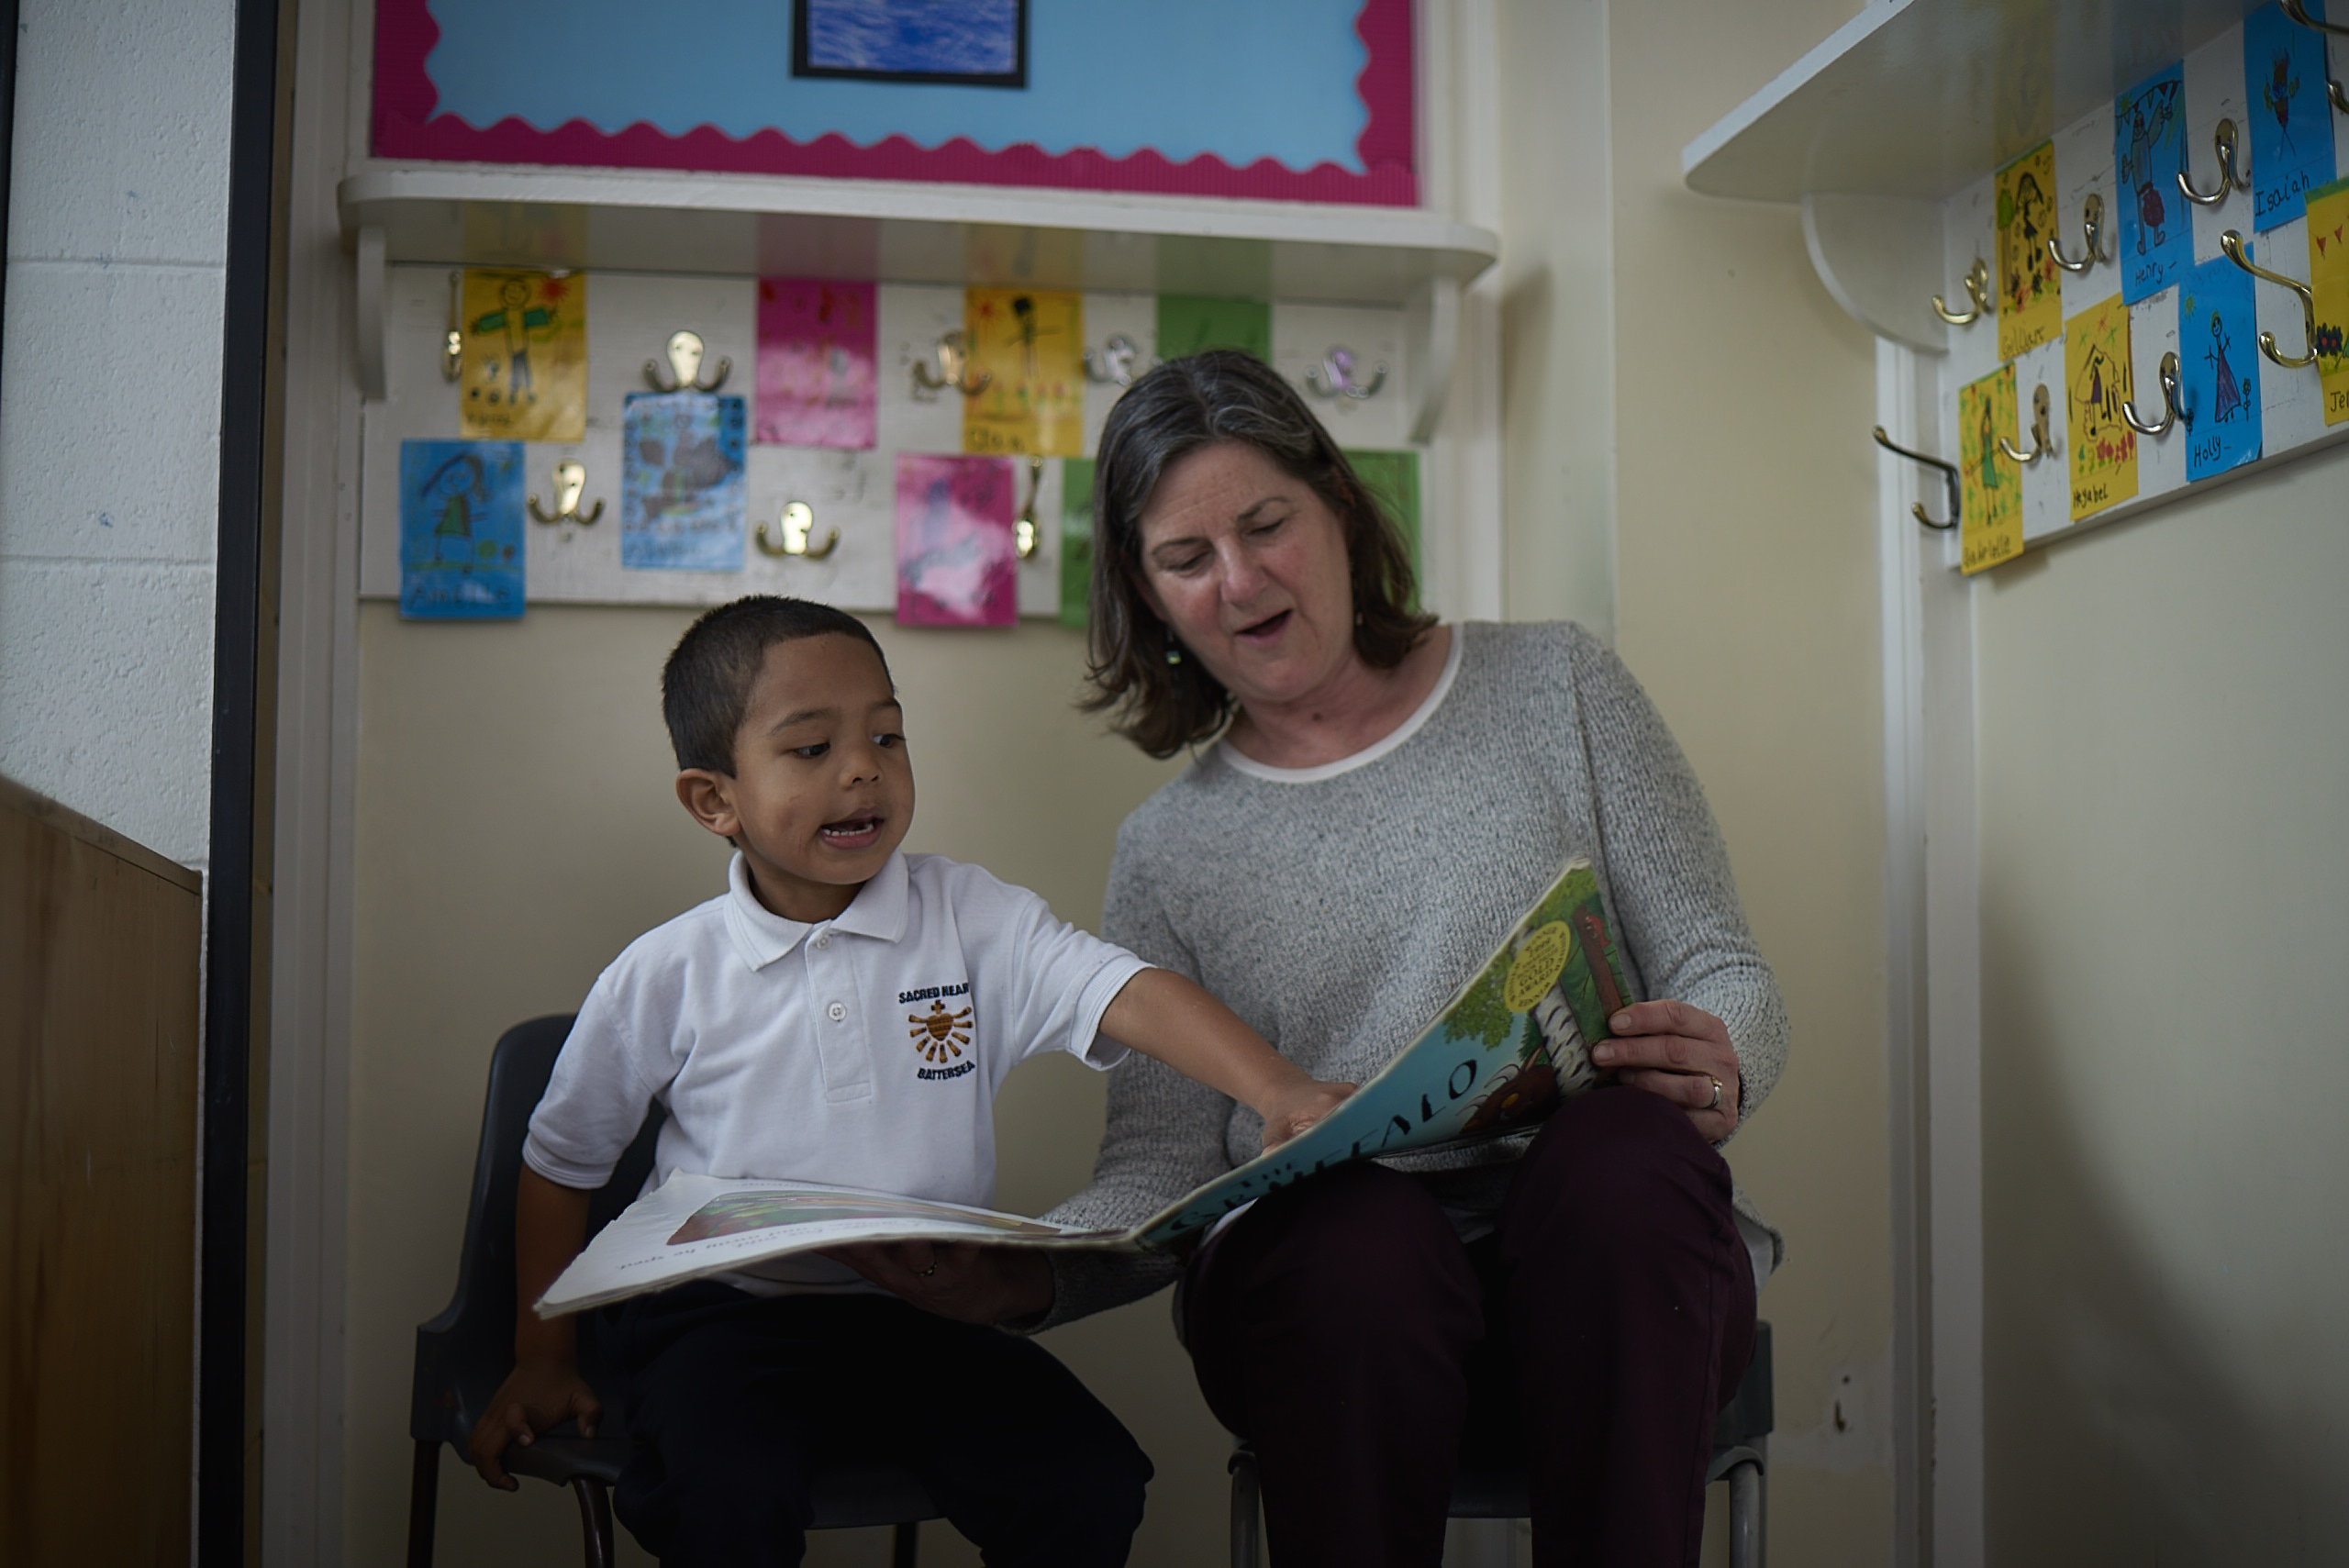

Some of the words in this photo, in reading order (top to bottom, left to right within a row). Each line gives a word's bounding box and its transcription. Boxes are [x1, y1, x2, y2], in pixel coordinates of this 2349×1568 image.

[2254, 170, 2310, 217] Isaiah
[2134, 261, 2164, 287] Henry
[2194, 435, 2221, 468] Holly
[899, 987, 941, 1004] SACRED
[918, 1060, 976, 1081] BATTERSEA
